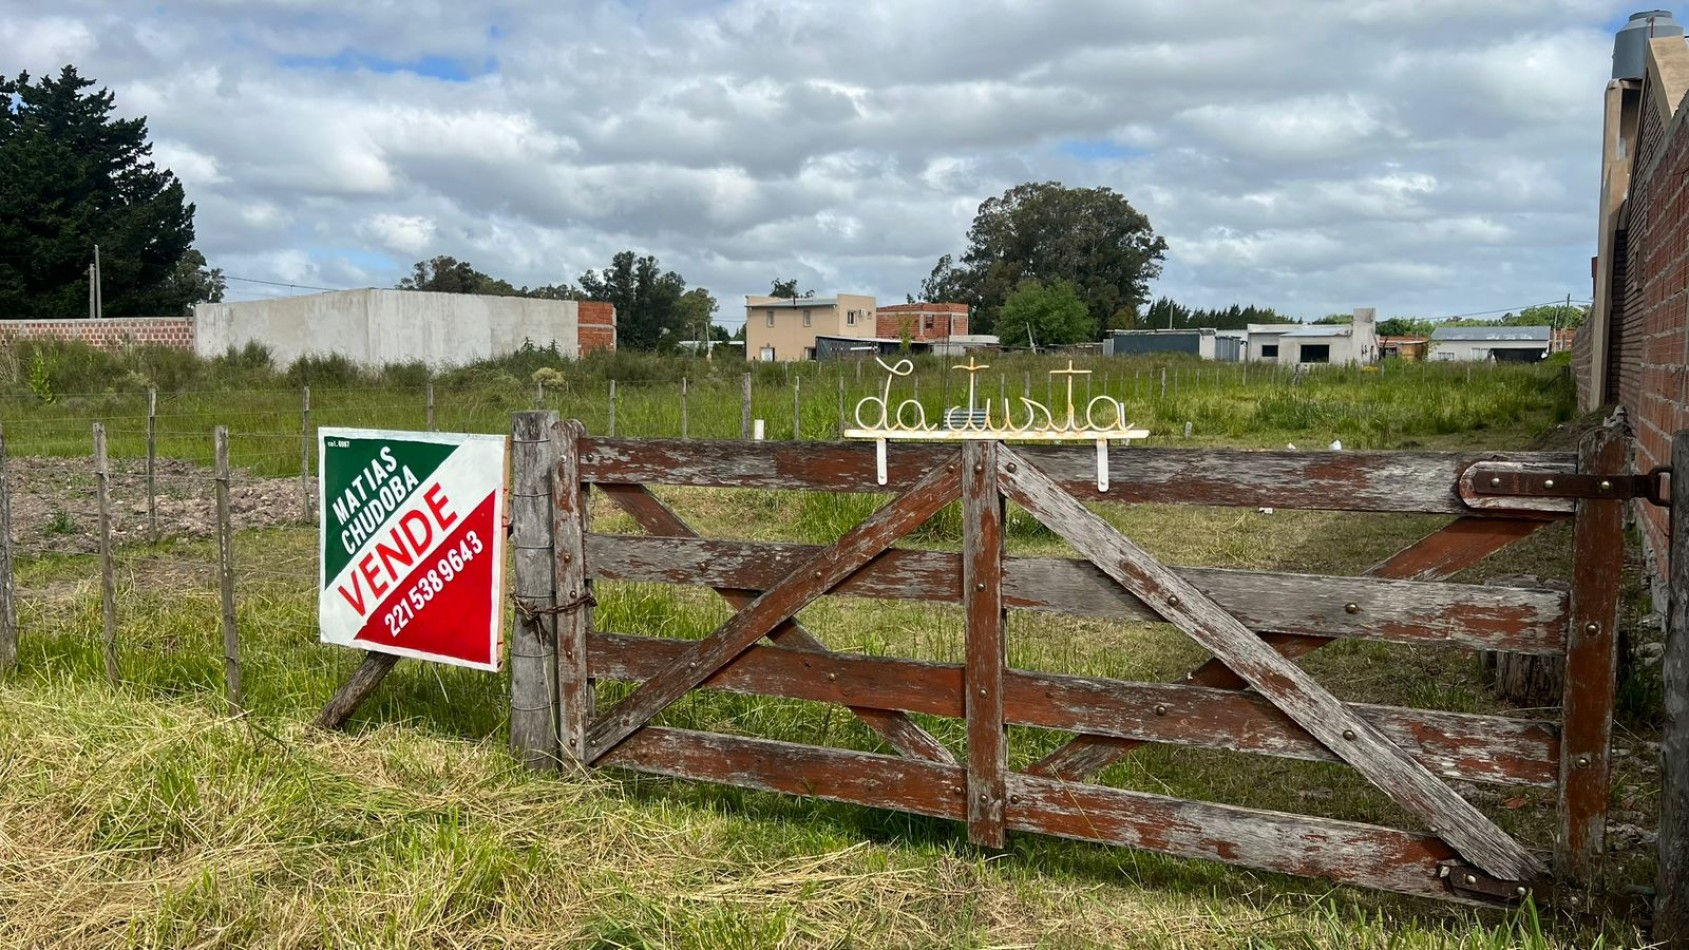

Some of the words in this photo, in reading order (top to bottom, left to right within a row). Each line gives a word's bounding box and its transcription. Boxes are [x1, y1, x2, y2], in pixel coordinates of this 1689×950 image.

[332, 446, 397, 525] MATIAS
[341, 465, 419, 554] CHUDOBA
[338, 482, 458, 617] VENDE
[384, 597, 414, 637] 221
[408, 569, 443, 610] 538
[437, 530, 483, 582] 9643
